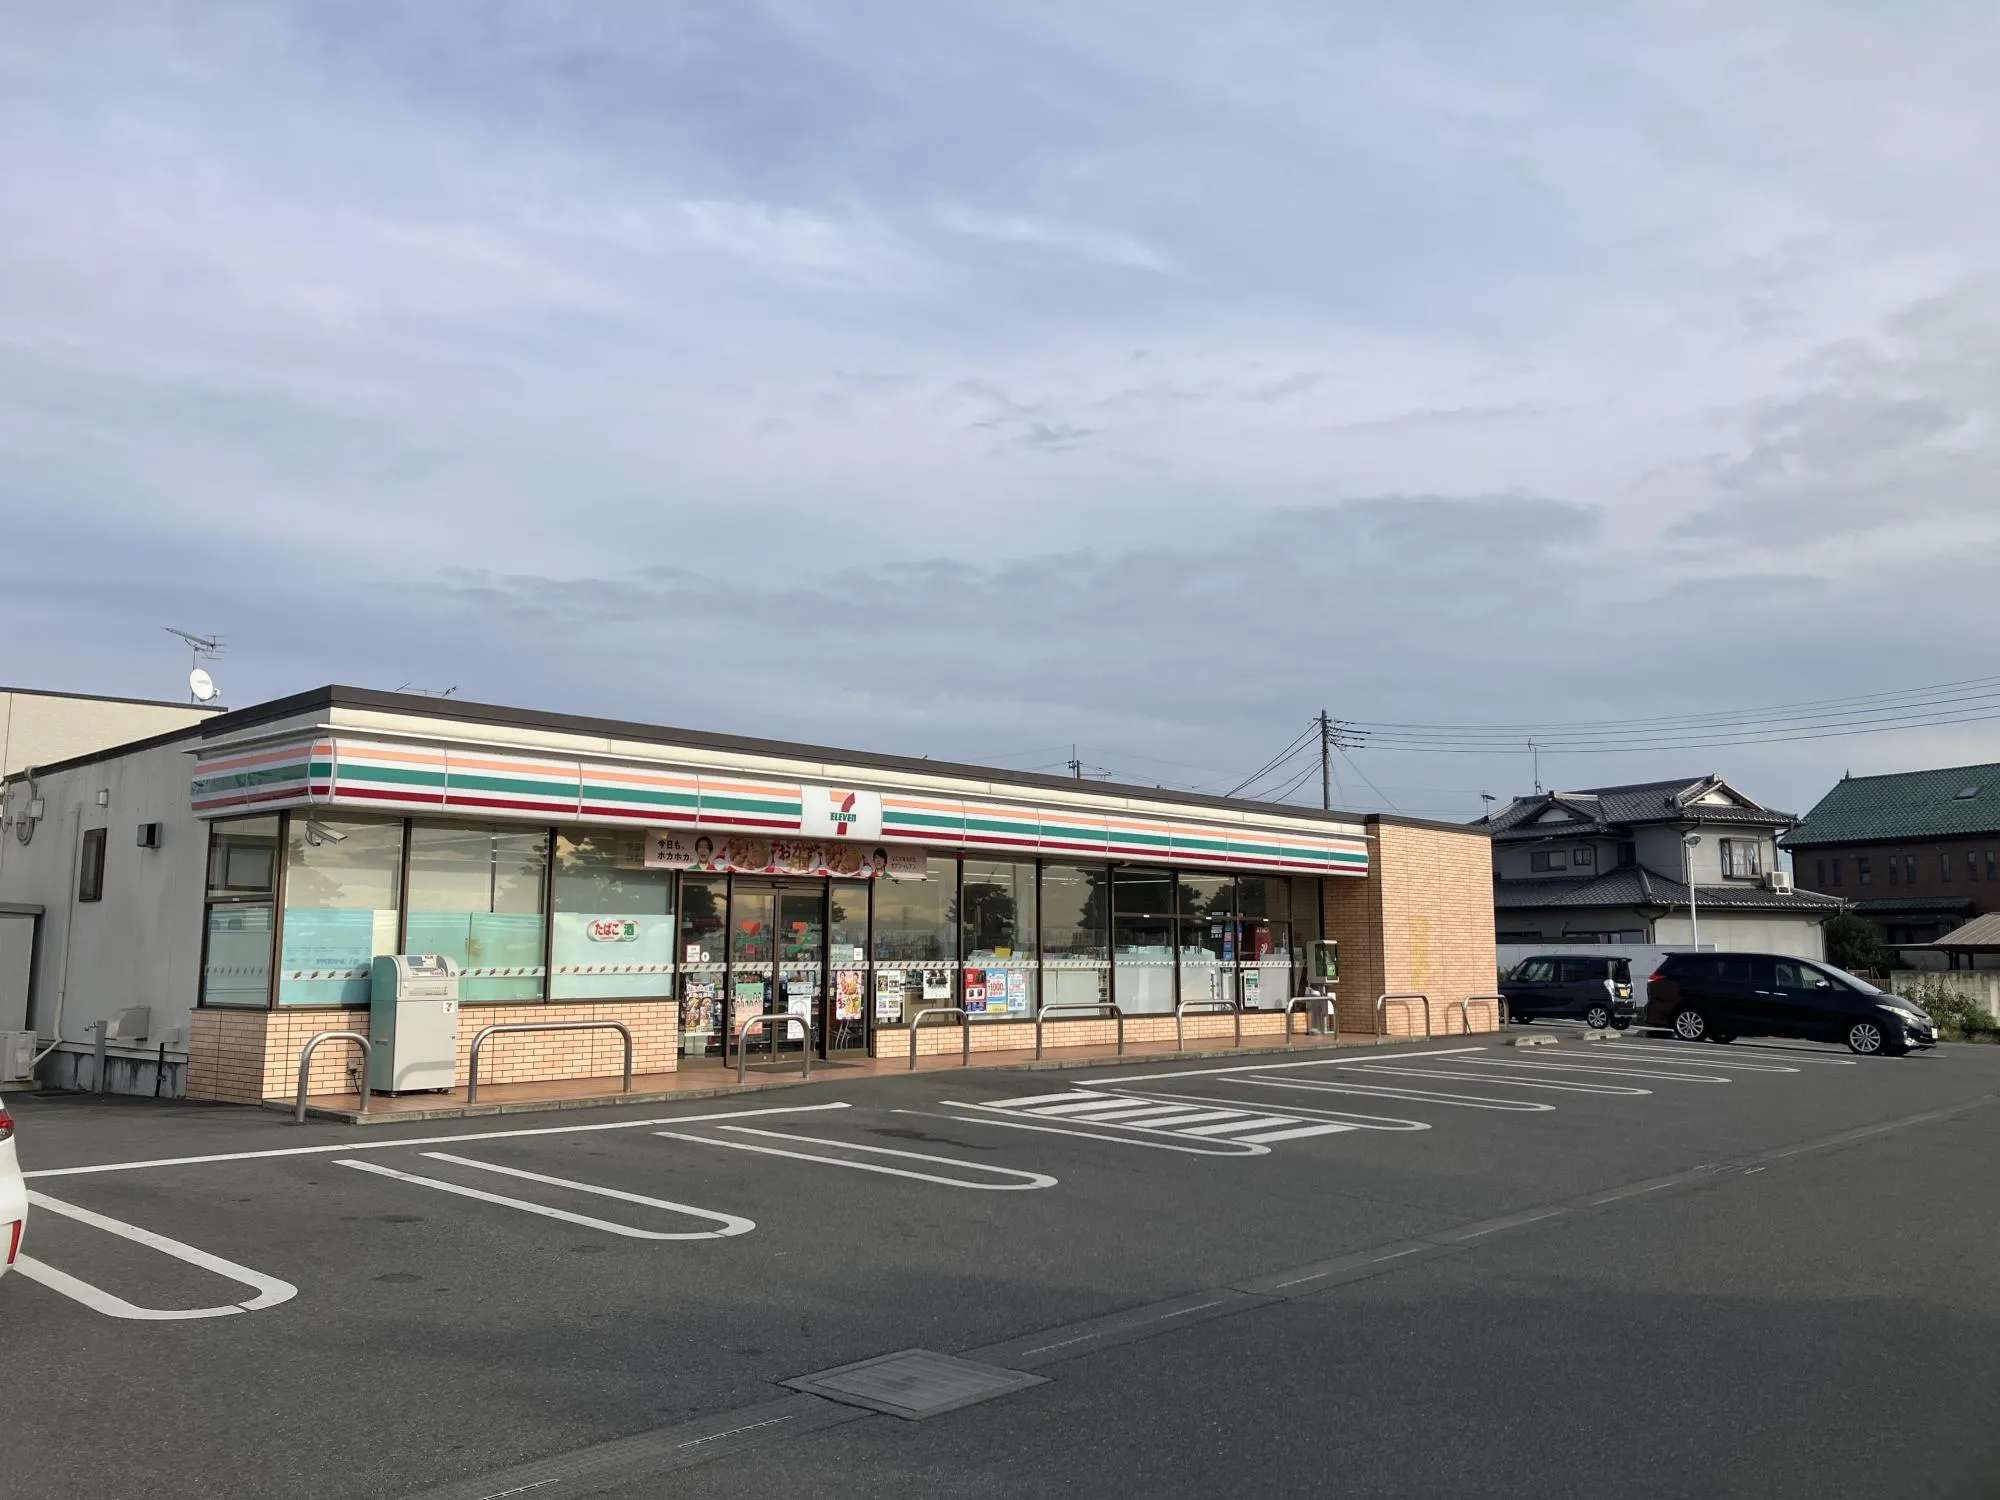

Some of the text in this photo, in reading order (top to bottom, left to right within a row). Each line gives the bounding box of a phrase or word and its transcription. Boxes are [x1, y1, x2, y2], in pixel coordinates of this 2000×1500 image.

[830, 812, 857, 823] ELEVEN
[594, 922, 635, 936] たばこ 酒
